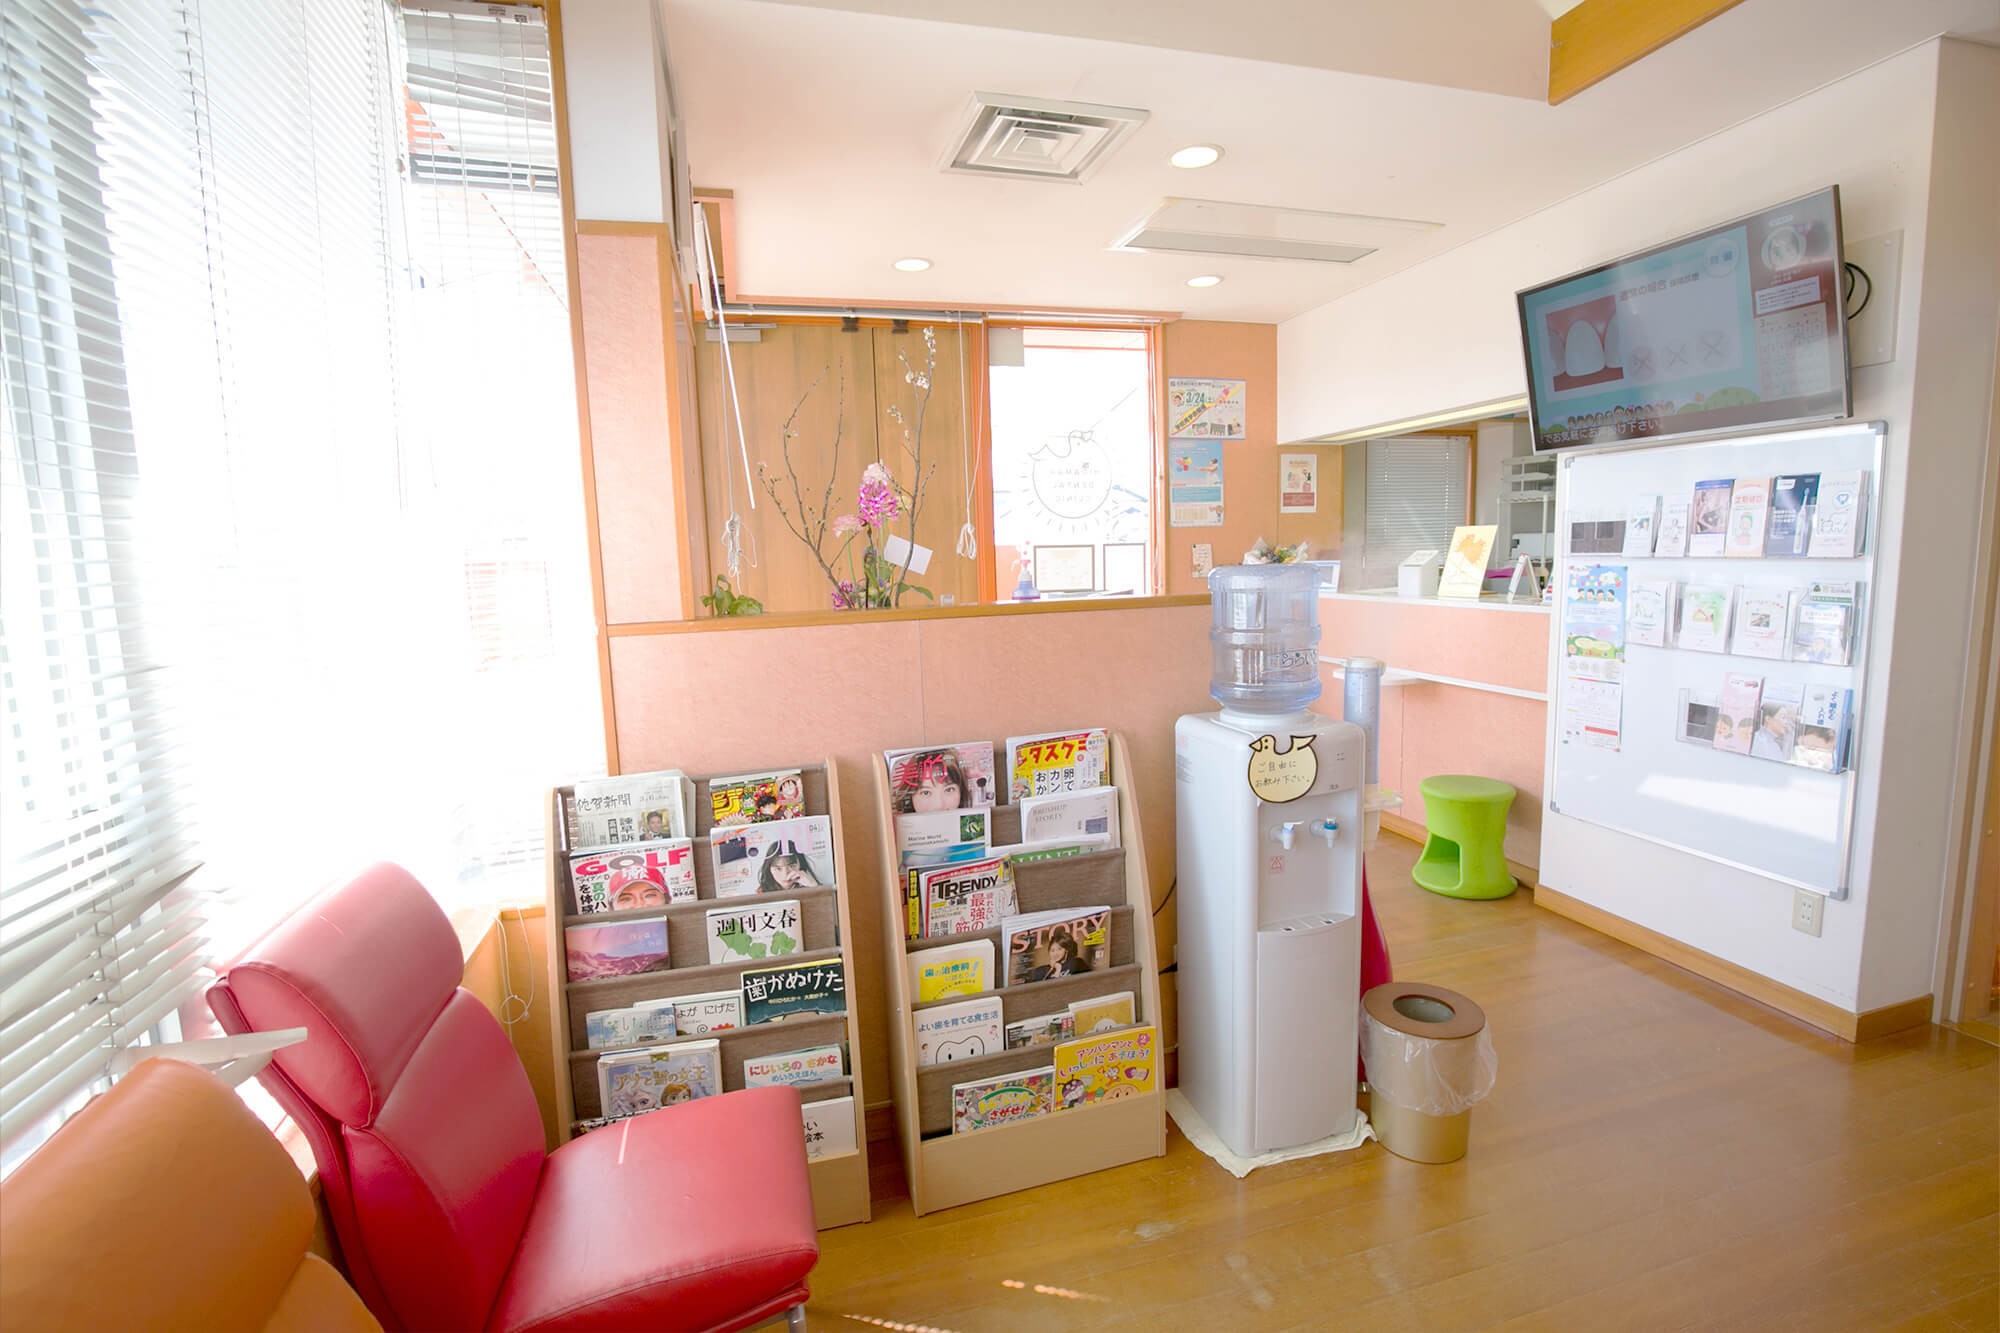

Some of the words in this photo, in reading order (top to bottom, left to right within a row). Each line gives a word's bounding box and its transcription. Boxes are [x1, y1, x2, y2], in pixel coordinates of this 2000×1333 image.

[892, 754, 947, 790] 美的
[1257, 760, 1297, 773] ご自由に
[1036, 772, 1047, 795] おか
[1050, 770, 1061, 793] カン
[576, 793, 632, 811] 佐賀新聞
[576, 847, 691, 876] GOLF
[932, 875, 999, 899] TRENDY
[716, 908, 798, 938] 週刊文春
[970, 892, 986, 931] 最強の
[1010, 912, 1108, 955] STORY
[744, 969, 844, 1002] 歯がぬけた
[918, 1010, 998, 1032] よい歯を育てる食生活
[749, 1060, 802, 1076] にじいろの
[807, 1055, 838, 1068] さかな
